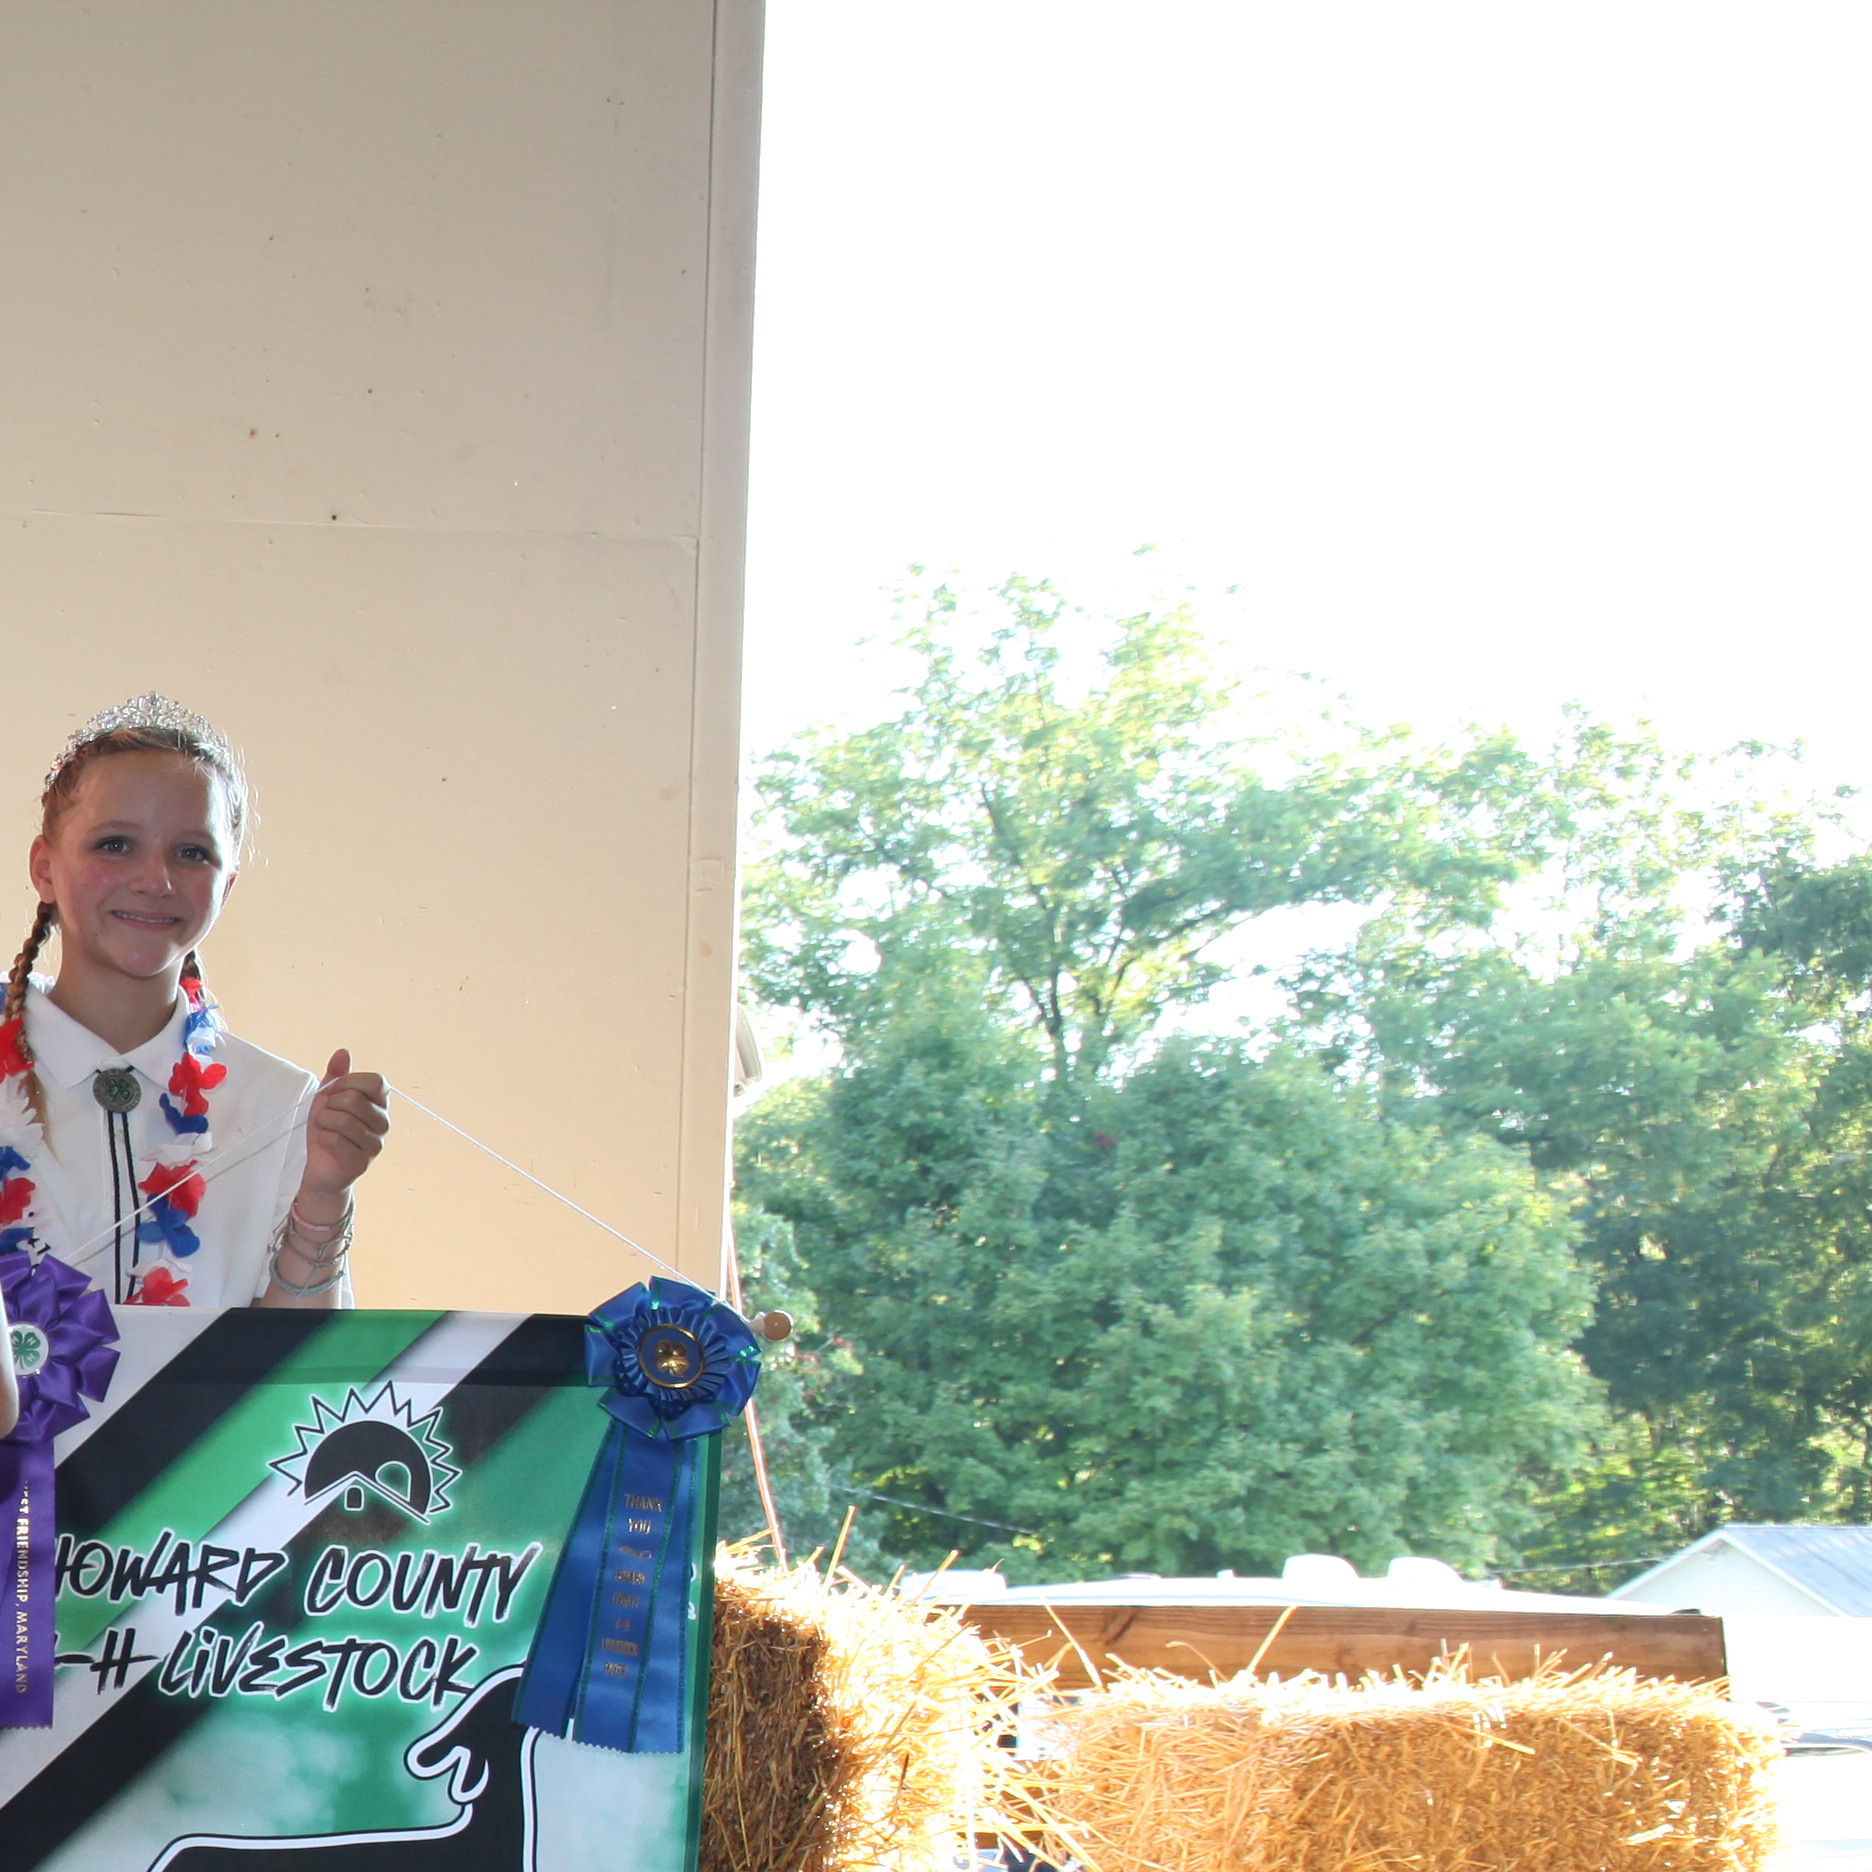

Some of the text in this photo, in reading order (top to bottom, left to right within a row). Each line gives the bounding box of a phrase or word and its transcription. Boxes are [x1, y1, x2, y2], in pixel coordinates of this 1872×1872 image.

[624, 1493, 663, 1513] THANK
[627, 1517, 652, 1535] YOU
[15, 1517, 30, 1607] FRIENDSHIP,
[305, 1542, 542, 1628] COUNTY
[15, 1611, 30, 1694] MARYLAND
[54, 1628, 159, 1695] -H
